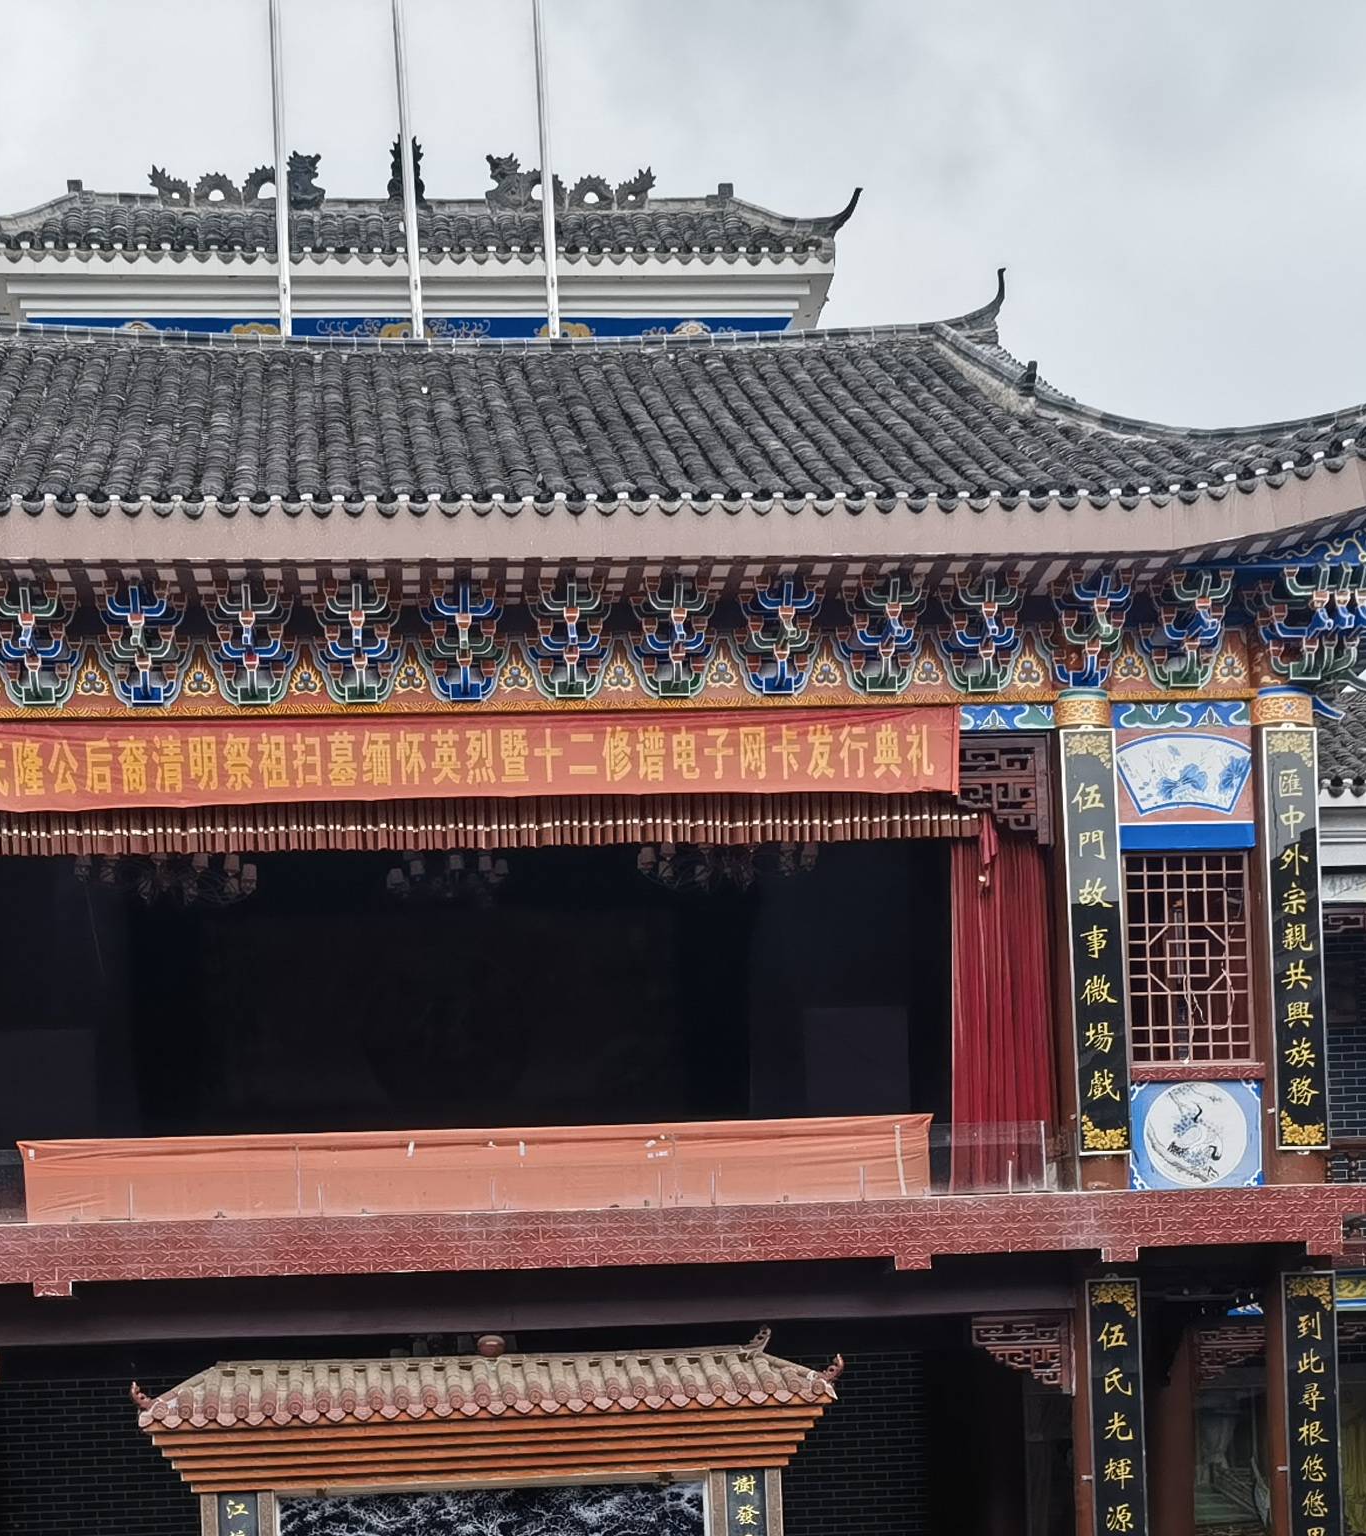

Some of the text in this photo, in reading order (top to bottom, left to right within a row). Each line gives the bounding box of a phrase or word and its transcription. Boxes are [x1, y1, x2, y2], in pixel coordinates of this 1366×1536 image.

[1071, 780, 1121, 1103] 伍門故事微場戲
[1277, 768, 1320, 1107] 匯中外宗親共興族務
